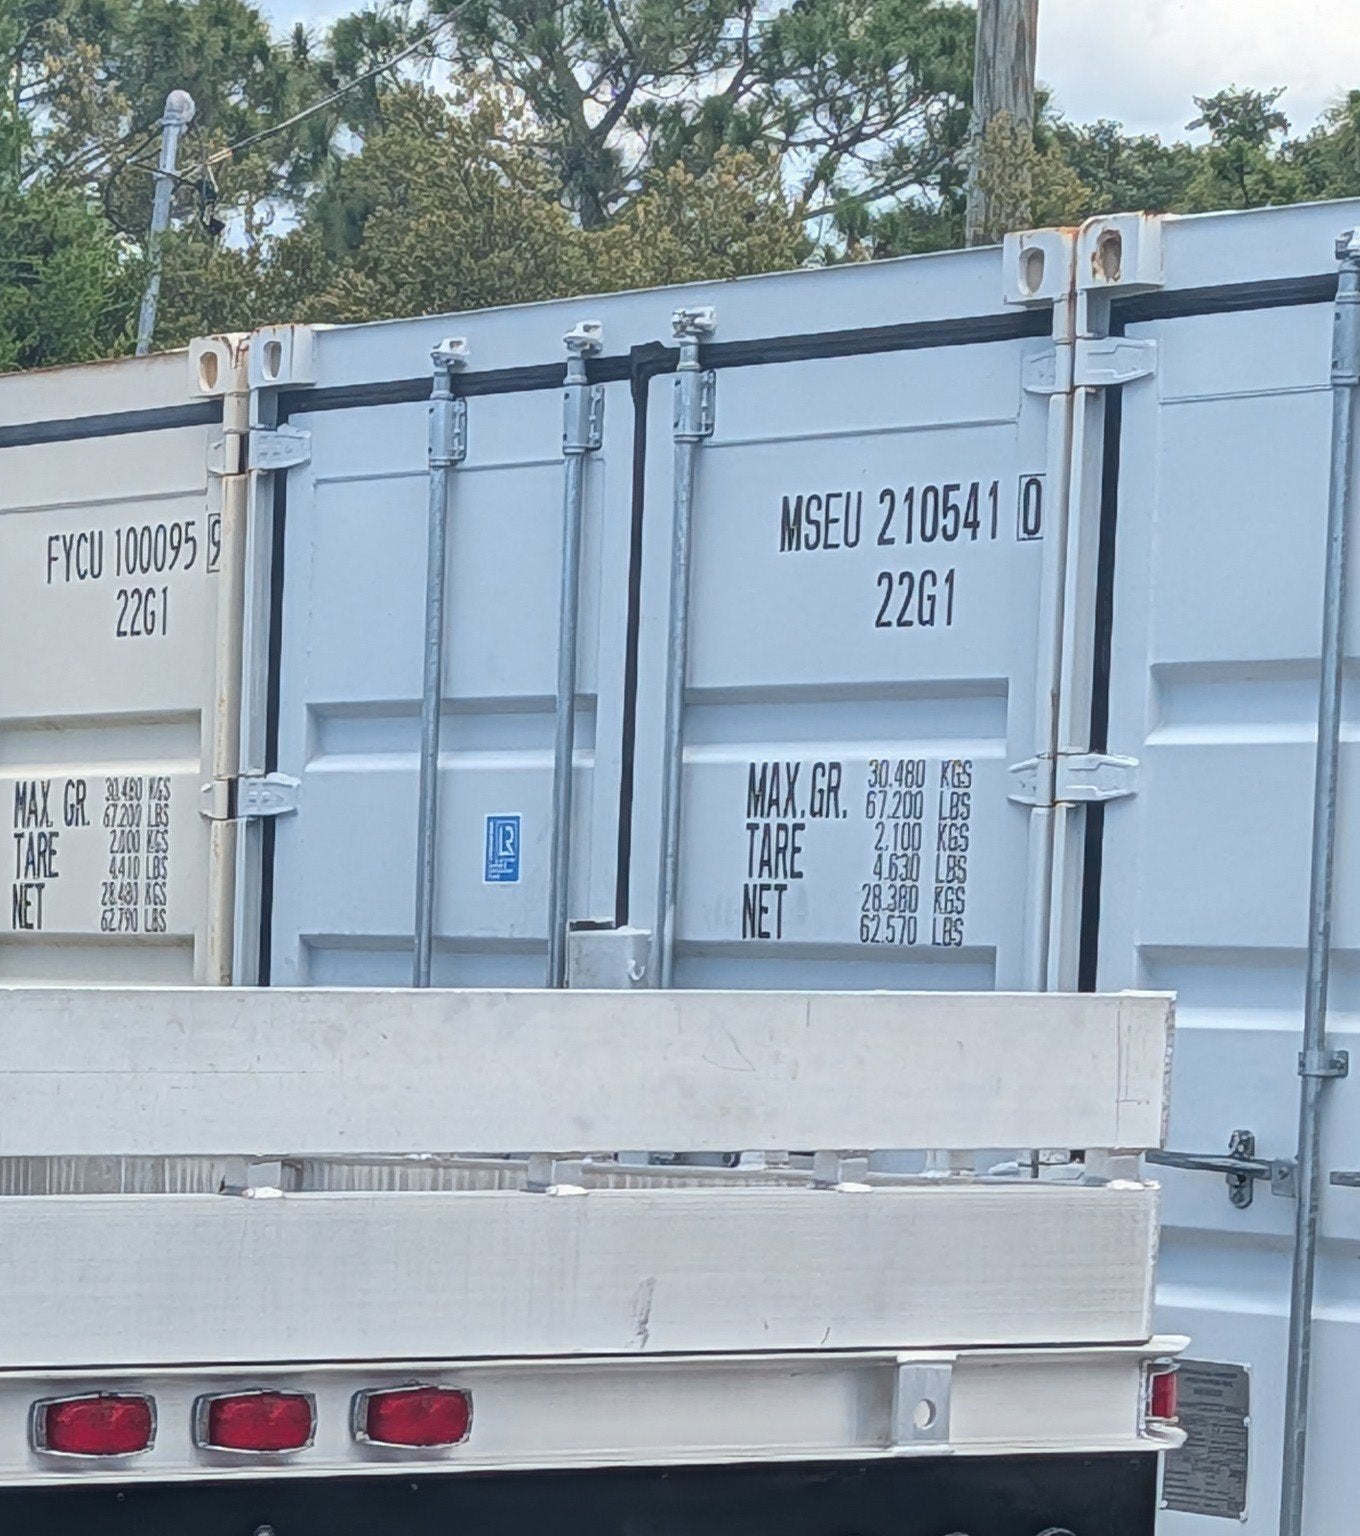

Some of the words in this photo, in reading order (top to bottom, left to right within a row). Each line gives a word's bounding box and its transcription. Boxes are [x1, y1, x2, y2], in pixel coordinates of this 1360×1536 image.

[779, 491, 862, 552] MSEU
[877, 480, 999, 546] 210541
[1021, 476, 1043, 537] 0
[47, 530, 103, 584] FYCU
[115, 520, 197, 576] 100095
[116, 586, 168, 637] 22G1
[875, 568, 955, 628] 22G1
[868, 759, 926, 789] 30.480
[940, 759, 973, 789] KGS
[148, 803, 169, 828] LBS
[866, 790, 924, 819] 67.200
[939, 791, 971, 820] LBS
[746, 823, 805, 879] TARE
[937, 822, 969, 852] KGS
[13, 831, 59, 879] TARE
[146, 855, 168, 880] LBS
[872, 853, 920, 882] 4.630
[935, 853, 968, 884] LBS
[12, 882, 45, 930] NET
[742, 883, 787, 939] NET
[933, 885, 965, 915] KGS
[144, 908, 167, 932] LBS
[859, 914, 917, 945] 62.570
[932, 917, 964, 946] LBS
